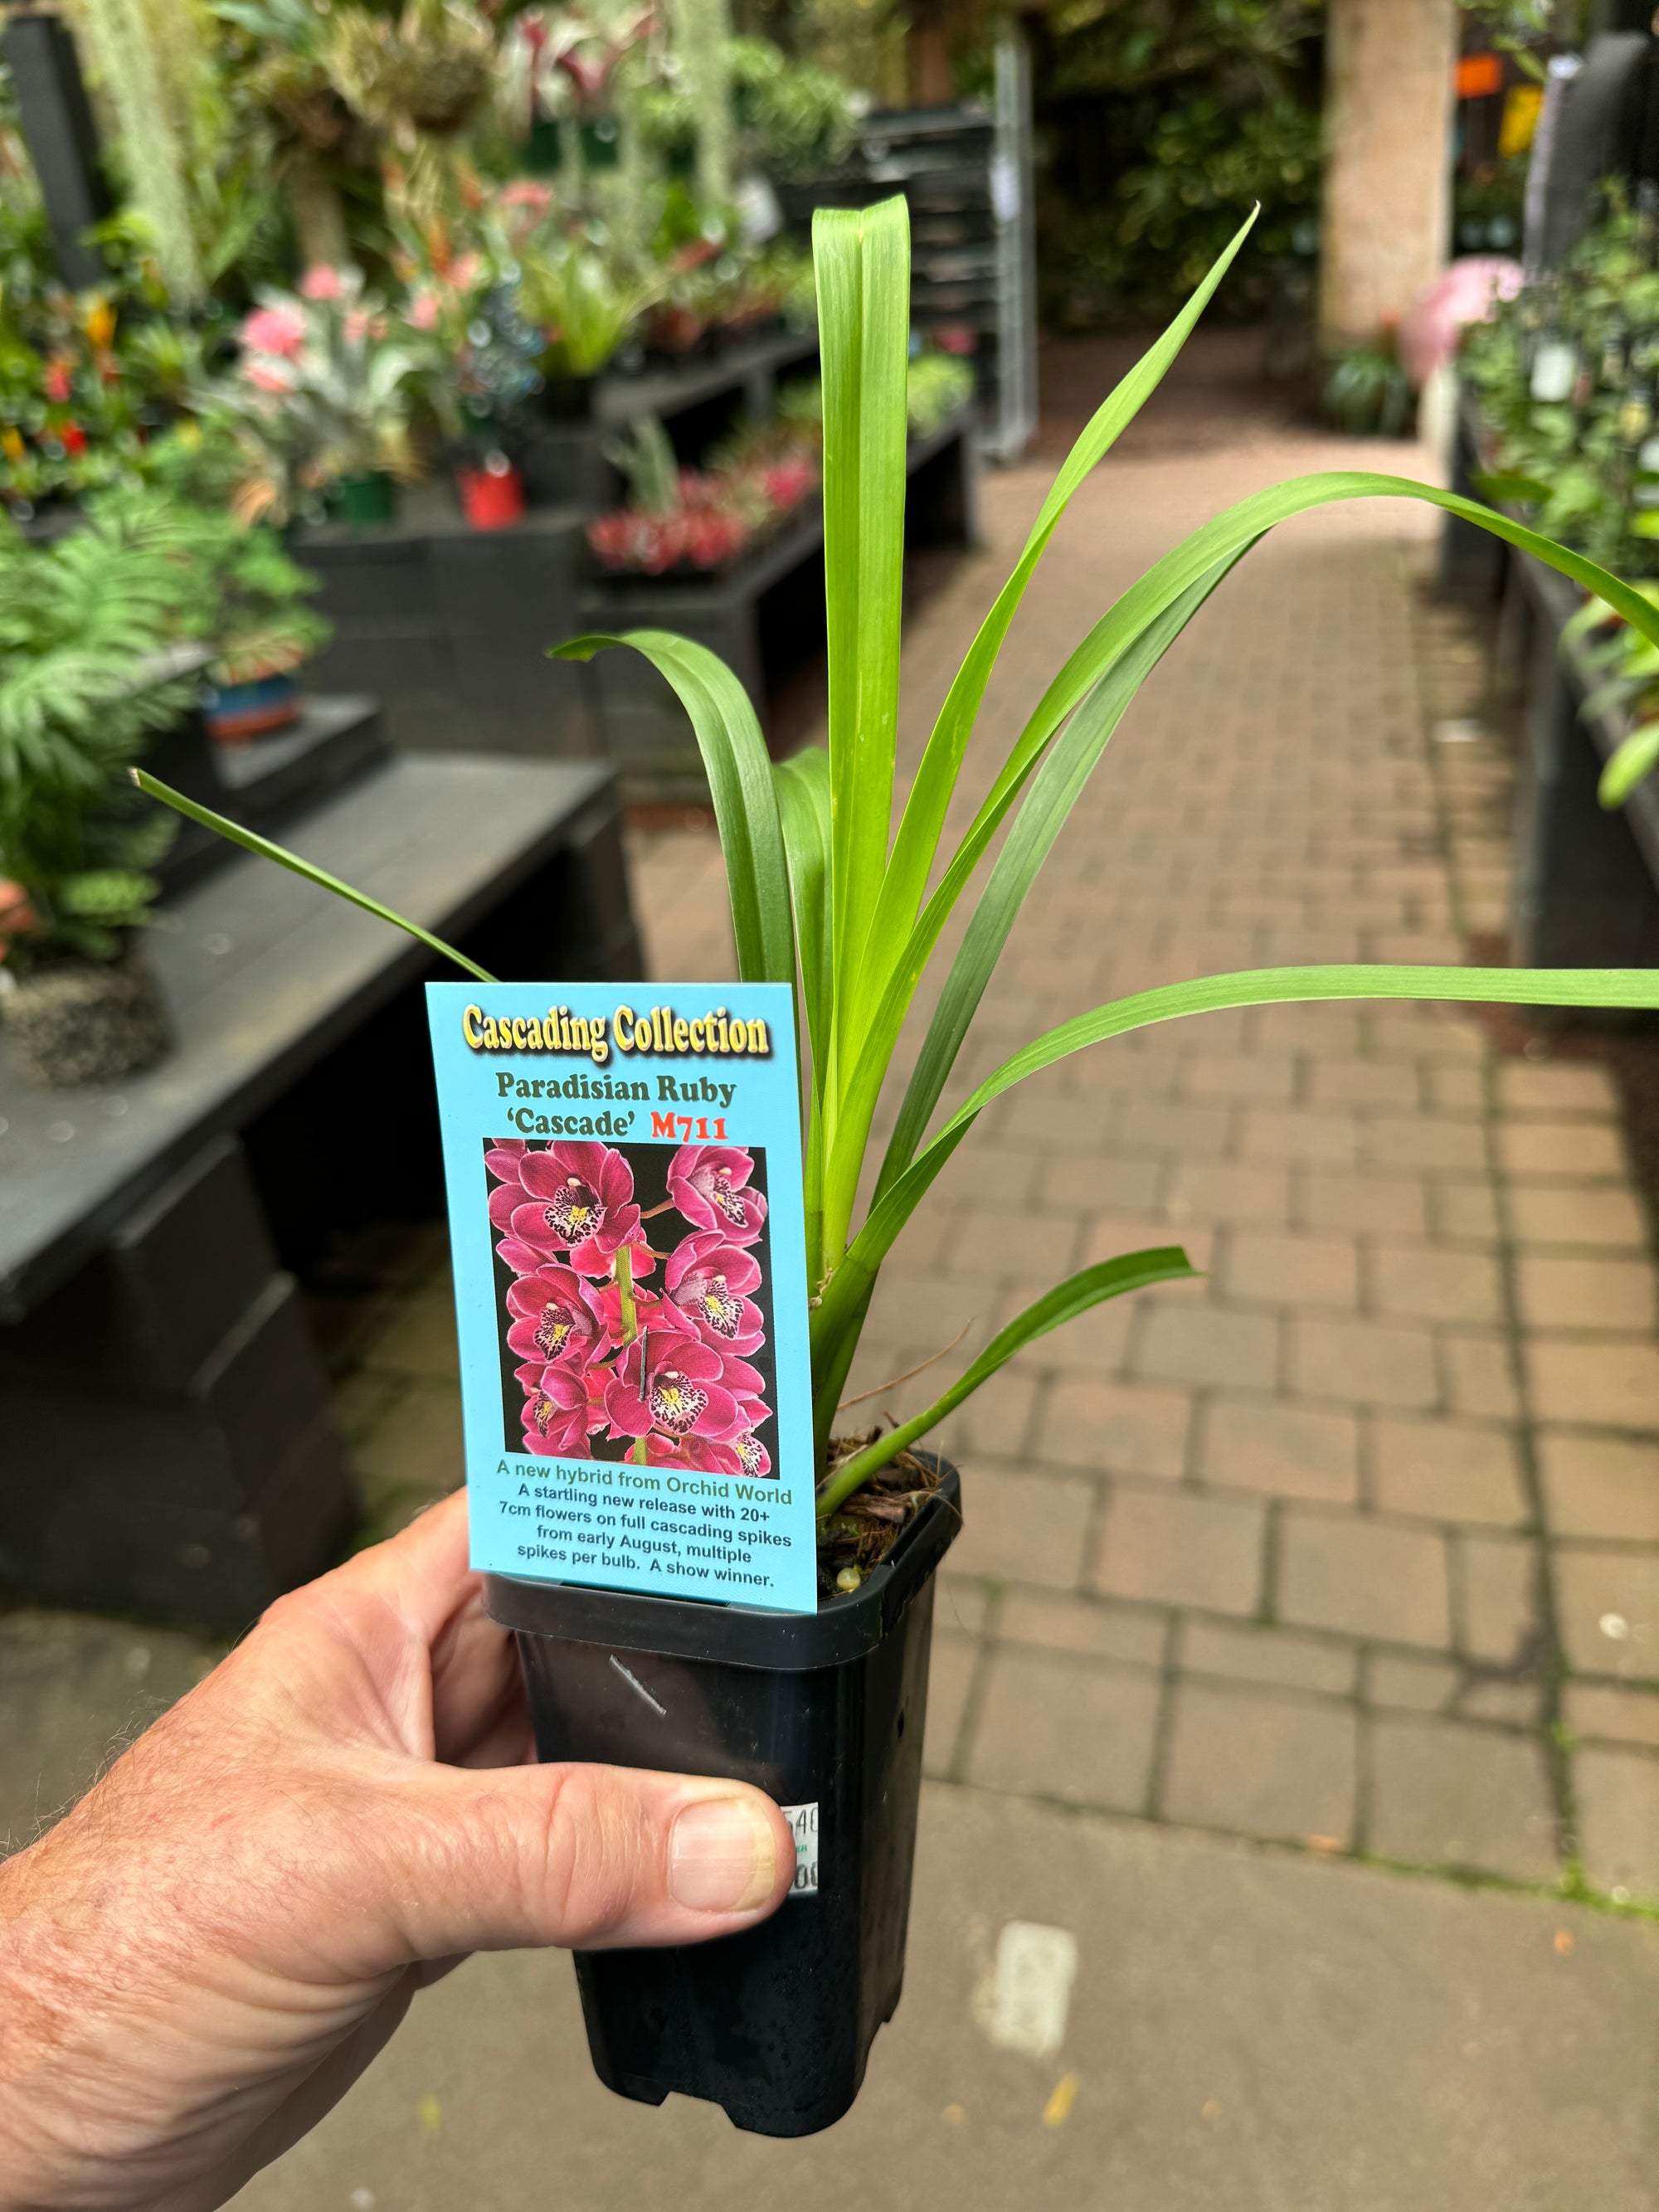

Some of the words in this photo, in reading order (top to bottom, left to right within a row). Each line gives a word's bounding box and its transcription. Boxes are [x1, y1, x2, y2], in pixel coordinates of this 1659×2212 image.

[464, 1004, 610, 1062] Cascading
[613, 1004, 769, 1053] Collection
[496, 1072, 650, 1101] Paradisian
[657, 1076, 737, 1108] Ruby
[650, 1111, 728, 1142] M711
[497, 1460, 510, 1475] A
[516, 1464, 550, 1479] new
[556, 1464, 613, 1485] hybrid
[618, 1471, 660, 1490] from
[666, 1477, 729, 1499] Orchid
[735, 1485, 792, 1505] World
[518, 1483, 530, 1496] A
[534, 1485, 597, 1506] startling
[602, 1494, 634, 1508] new
[639, 1498, 696, 1515] release
[702, 1505, 735, 1519] with
[740, 1508, 770, 1522] 20+
[499, 1501, 531, 1516] 7cm
[536, 1504, 591, 1524] flowers
[596, 1512, 615, 1526] on
[620, 1514, 645, 1530] full
[650, 1518, 732, 1543] cascading
[737, 1531, 791, 1548] spikes
[537, 1525, 572, 1542] from
[577, 1531, 615, 1549] early
[620, 1534, 681, 1558] August,
[686, 1543, 752, 1563] multiple
[518, 1544, 567, 1561] spikes
[572, 1550, 597, 1566] per
[601, 1553, 640, 1570] bulb.
[650, 1558, 661, 1573] A
[666, 1562, 709, 1579] show
[714, 1568, 774, 1587] winner.
